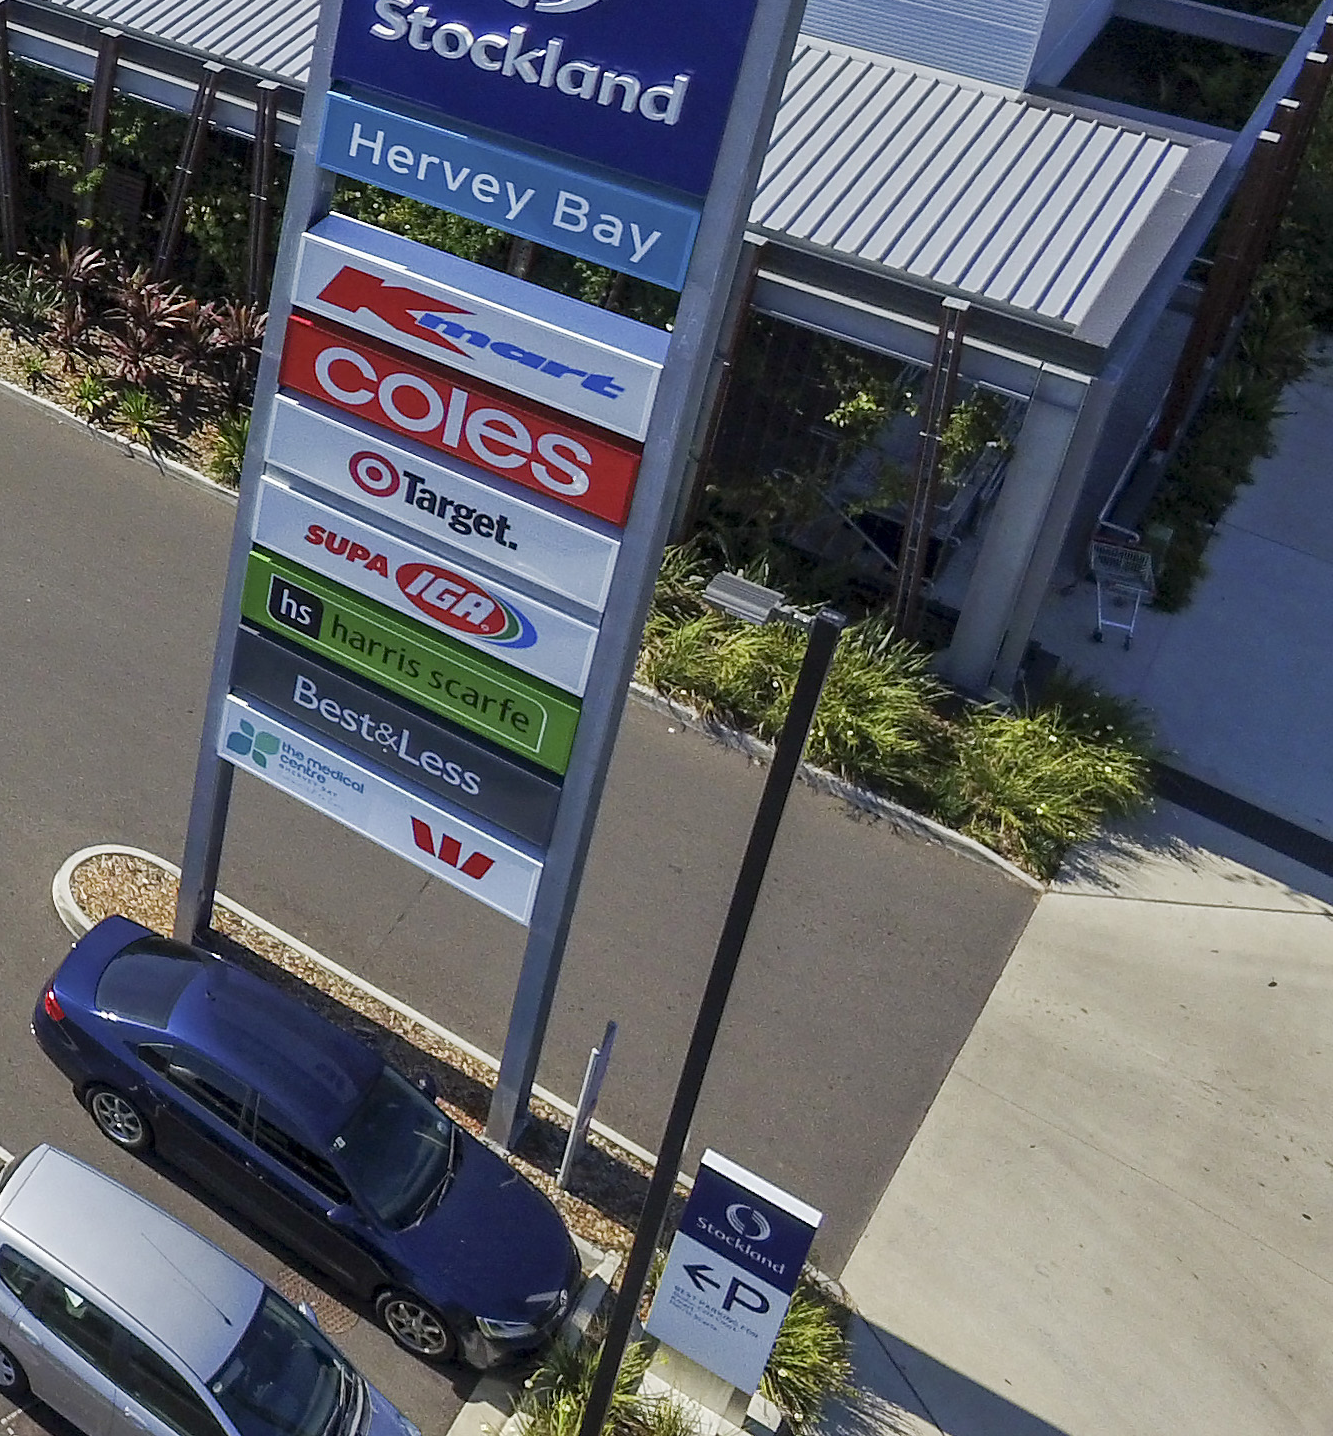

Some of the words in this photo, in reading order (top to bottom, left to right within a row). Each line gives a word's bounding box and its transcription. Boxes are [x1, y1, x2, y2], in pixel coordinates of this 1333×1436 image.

[348, 120, 536, 220] Hervey
[552, 189, 662, 263] Bay
[314, 346, 592, 498] coles
[304, 523, 390, 579] SUPA
[404, 570, 496, 626] IGA
[278, 589, 313, 626] hs
[331, 613, 420, 677] harris
[426, 664, 531, 735] scarfe
[282, 741, 305, 761] the
[307, 756, 365, 794] medical
[291, 674, 482, 796] Best&Less
[695, 1215, 786, 1276] Stockland
[721, 1275, 771, 1315] P
